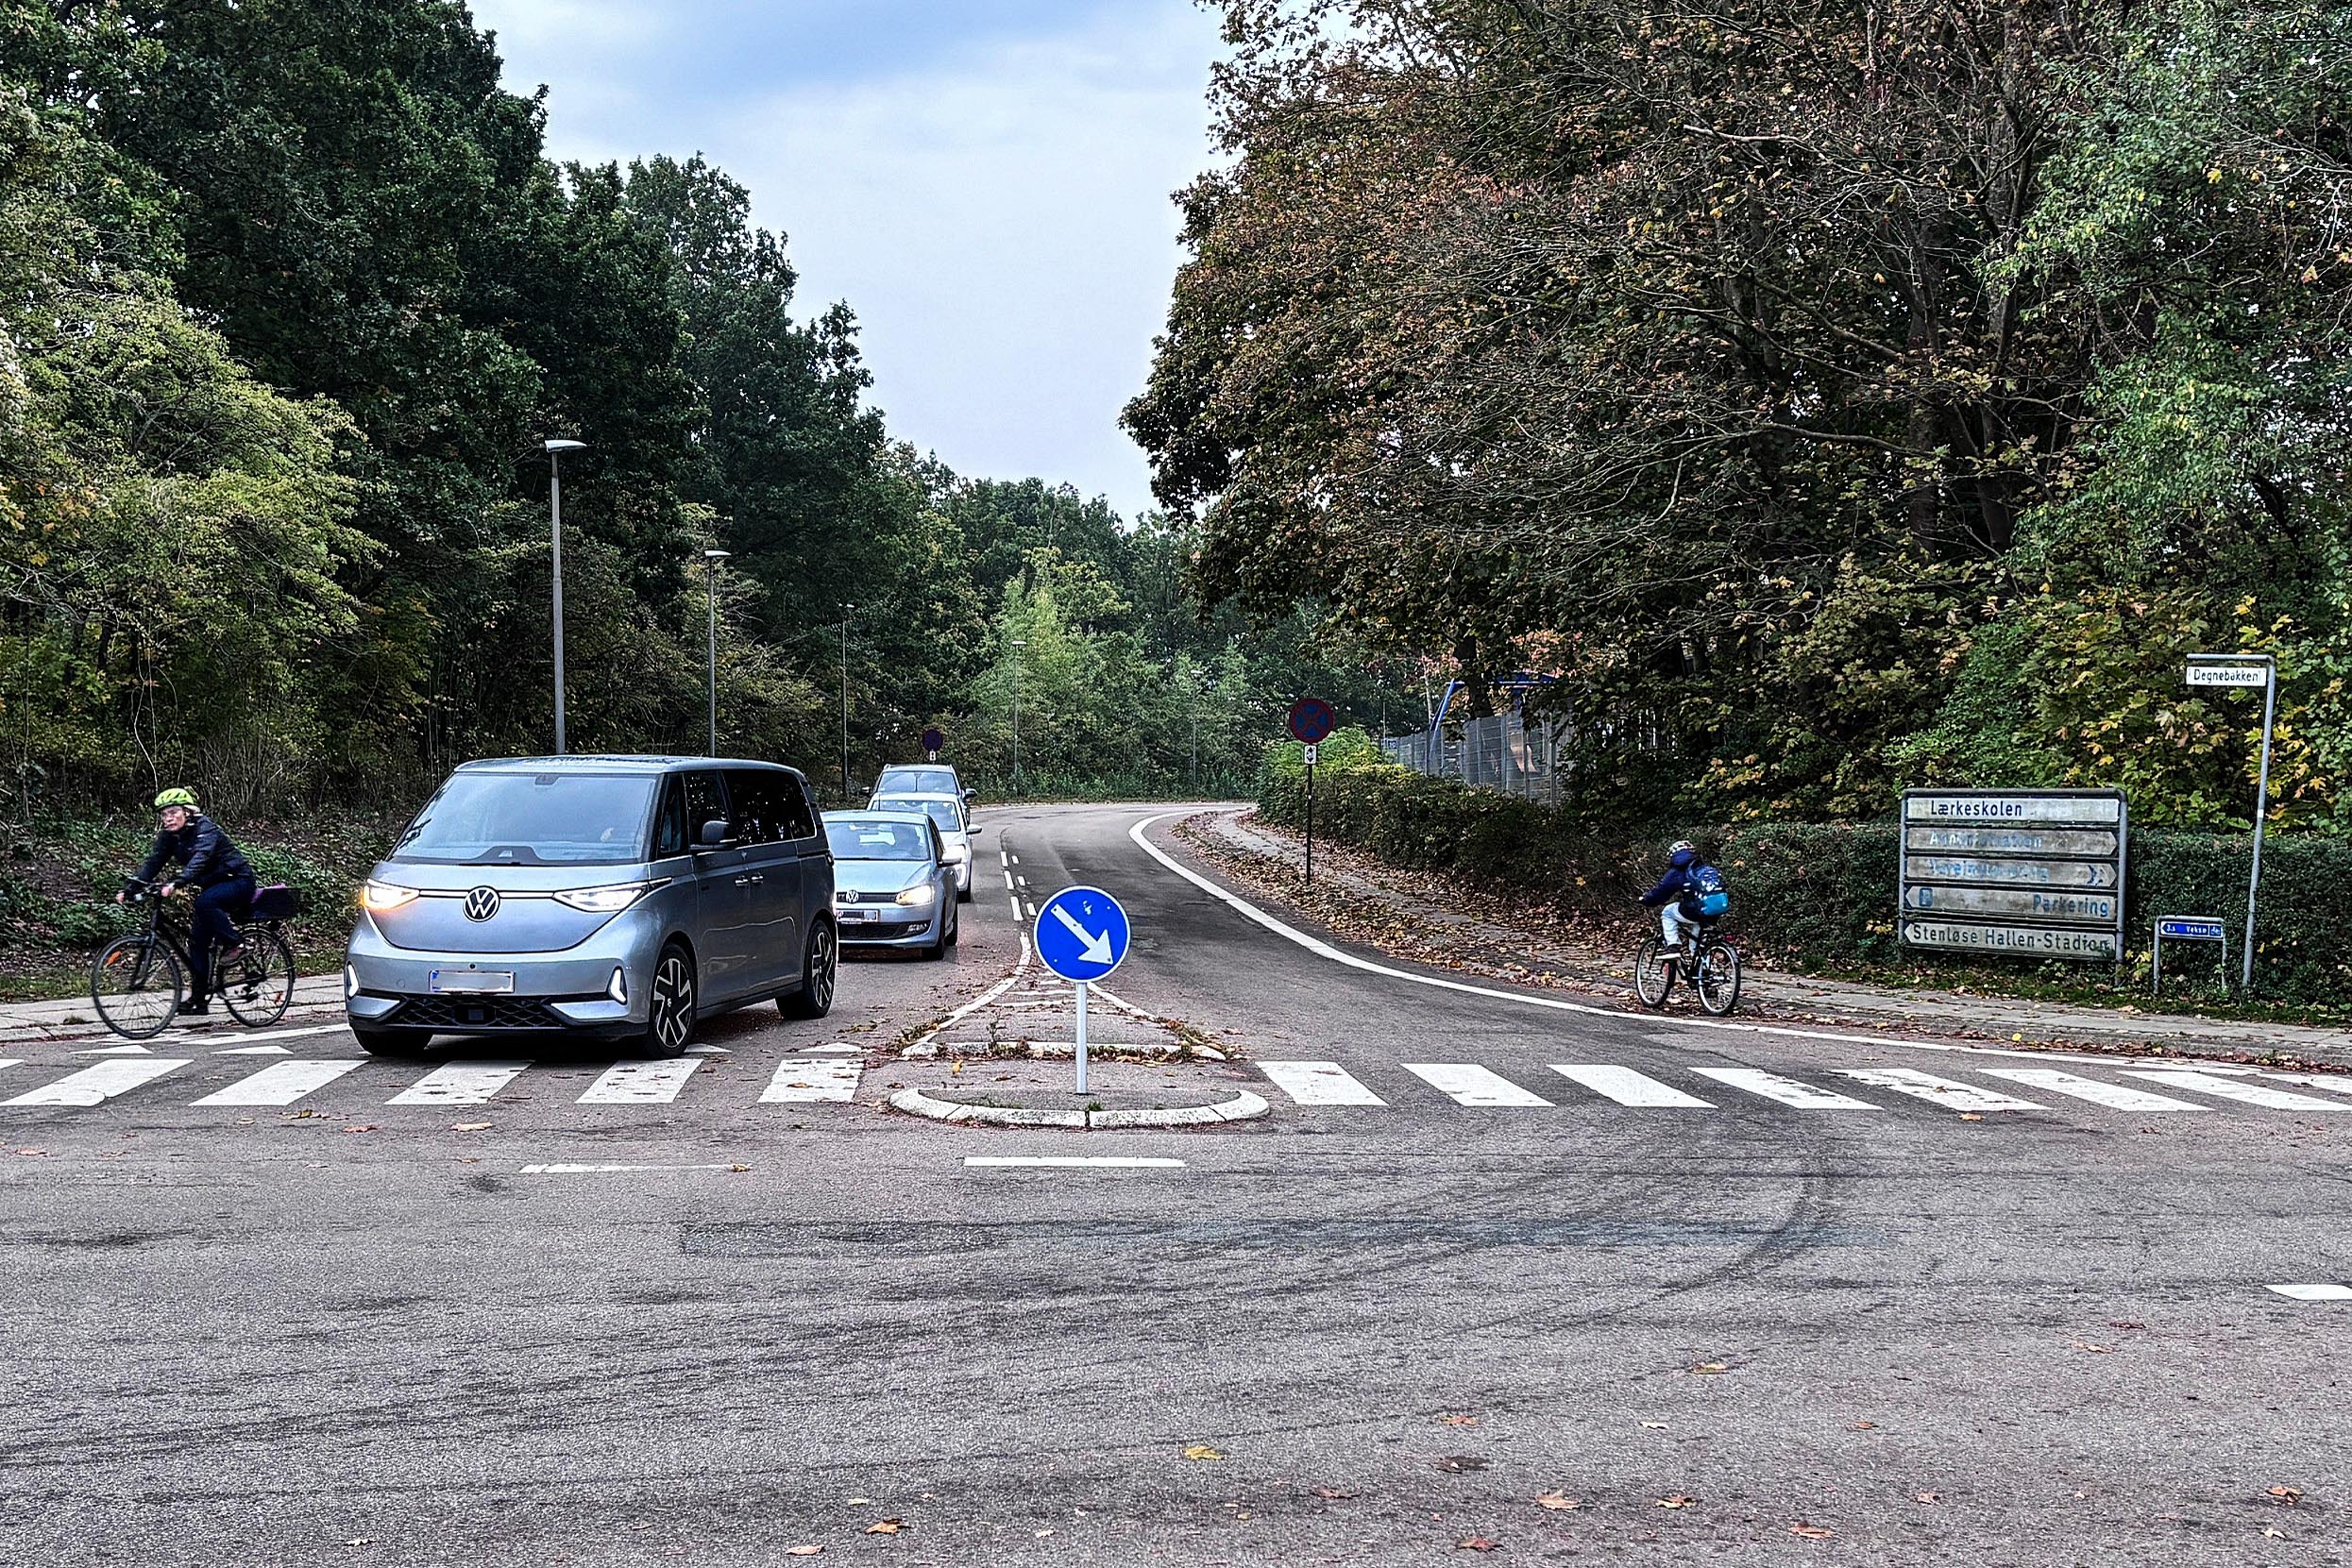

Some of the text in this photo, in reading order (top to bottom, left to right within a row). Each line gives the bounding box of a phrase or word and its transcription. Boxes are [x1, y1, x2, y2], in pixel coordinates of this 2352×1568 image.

[2193, 668, 2259, 684] Degnebakken
[1930, 800, 2023, 818] Lærkeskolen
[2032, 894, 2109, 918] Parkering
[1912, 923, 1978, 943] Stenløse
